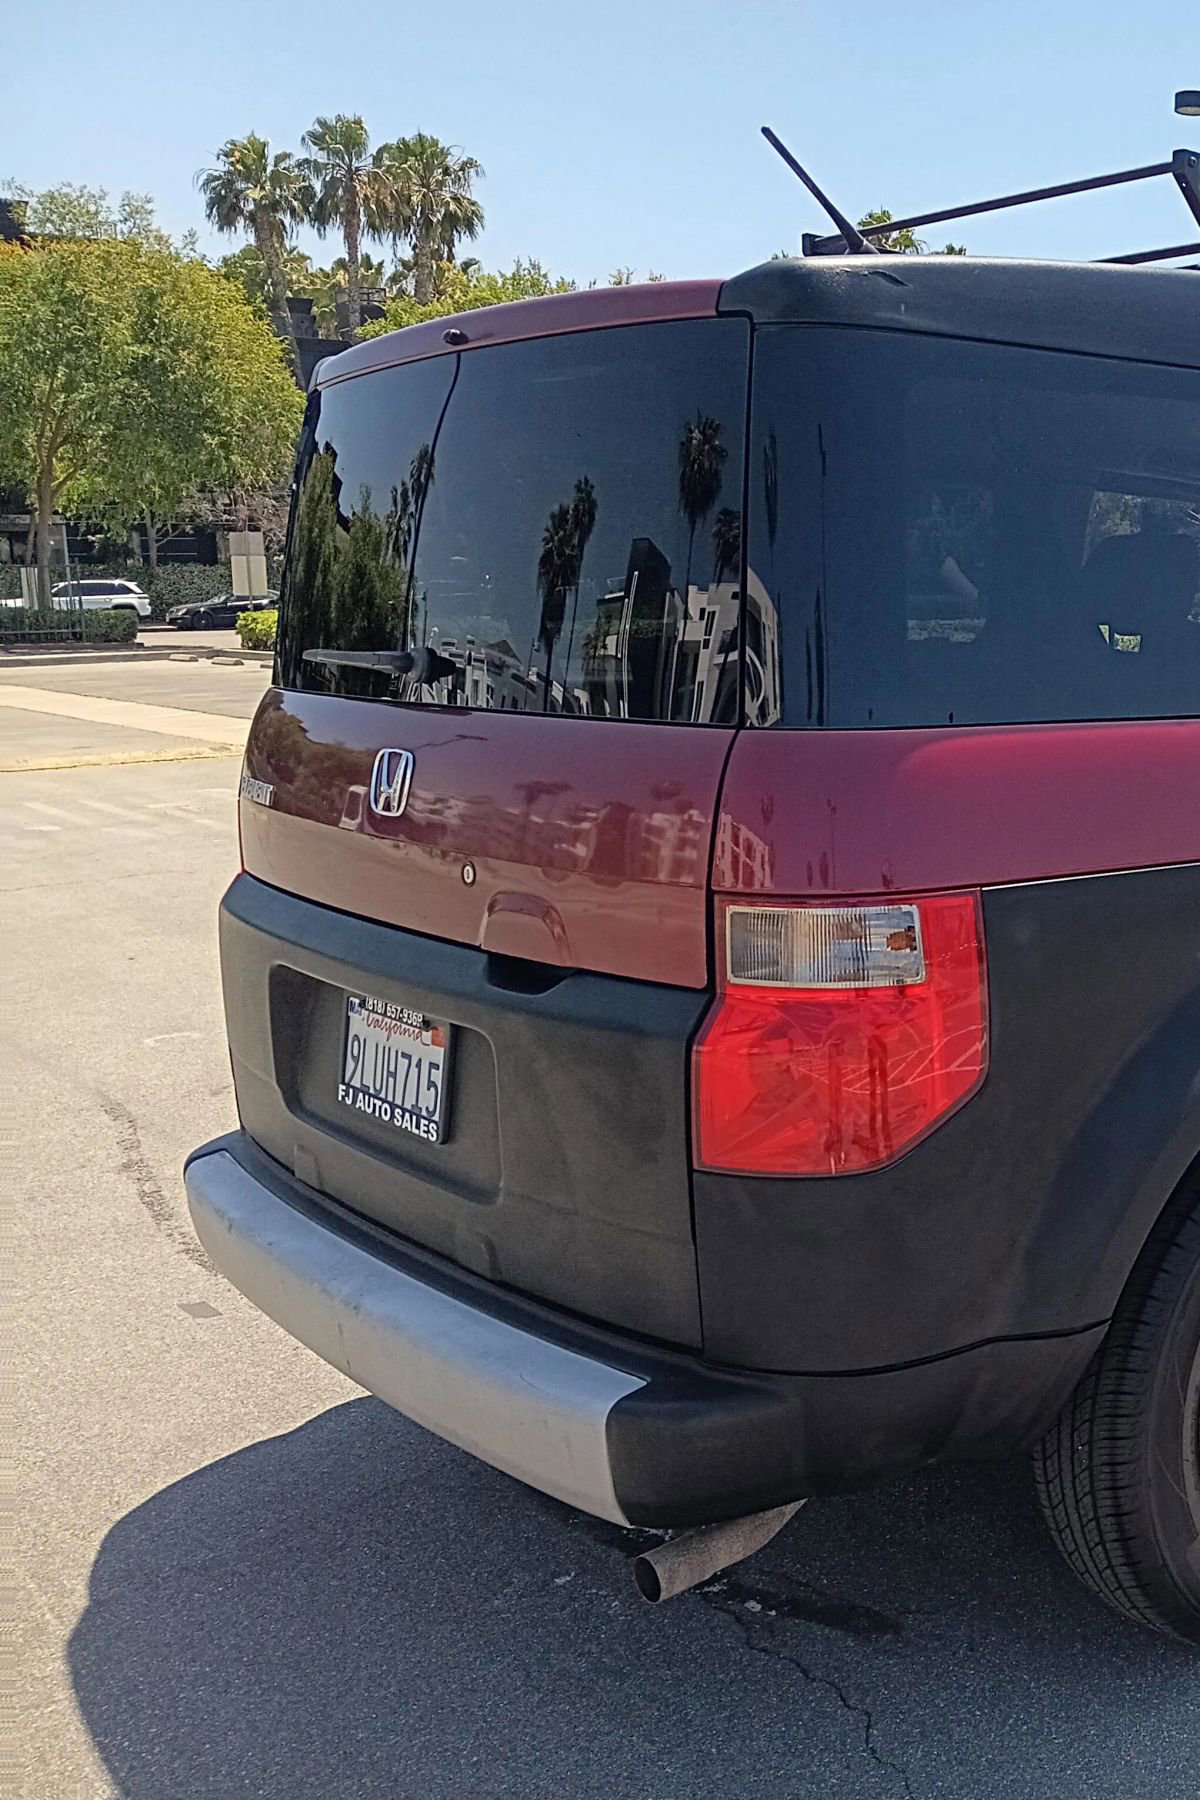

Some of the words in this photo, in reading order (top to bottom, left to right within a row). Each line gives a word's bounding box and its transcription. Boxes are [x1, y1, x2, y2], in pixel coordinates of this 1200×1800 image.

[347, 1034, 440, 1118] 9LUH715
[338, 1084, 353, 1104] FJ
[355, 1092, 391, 1121] AUTO
[393, 1108, 438, 1142] SALES
